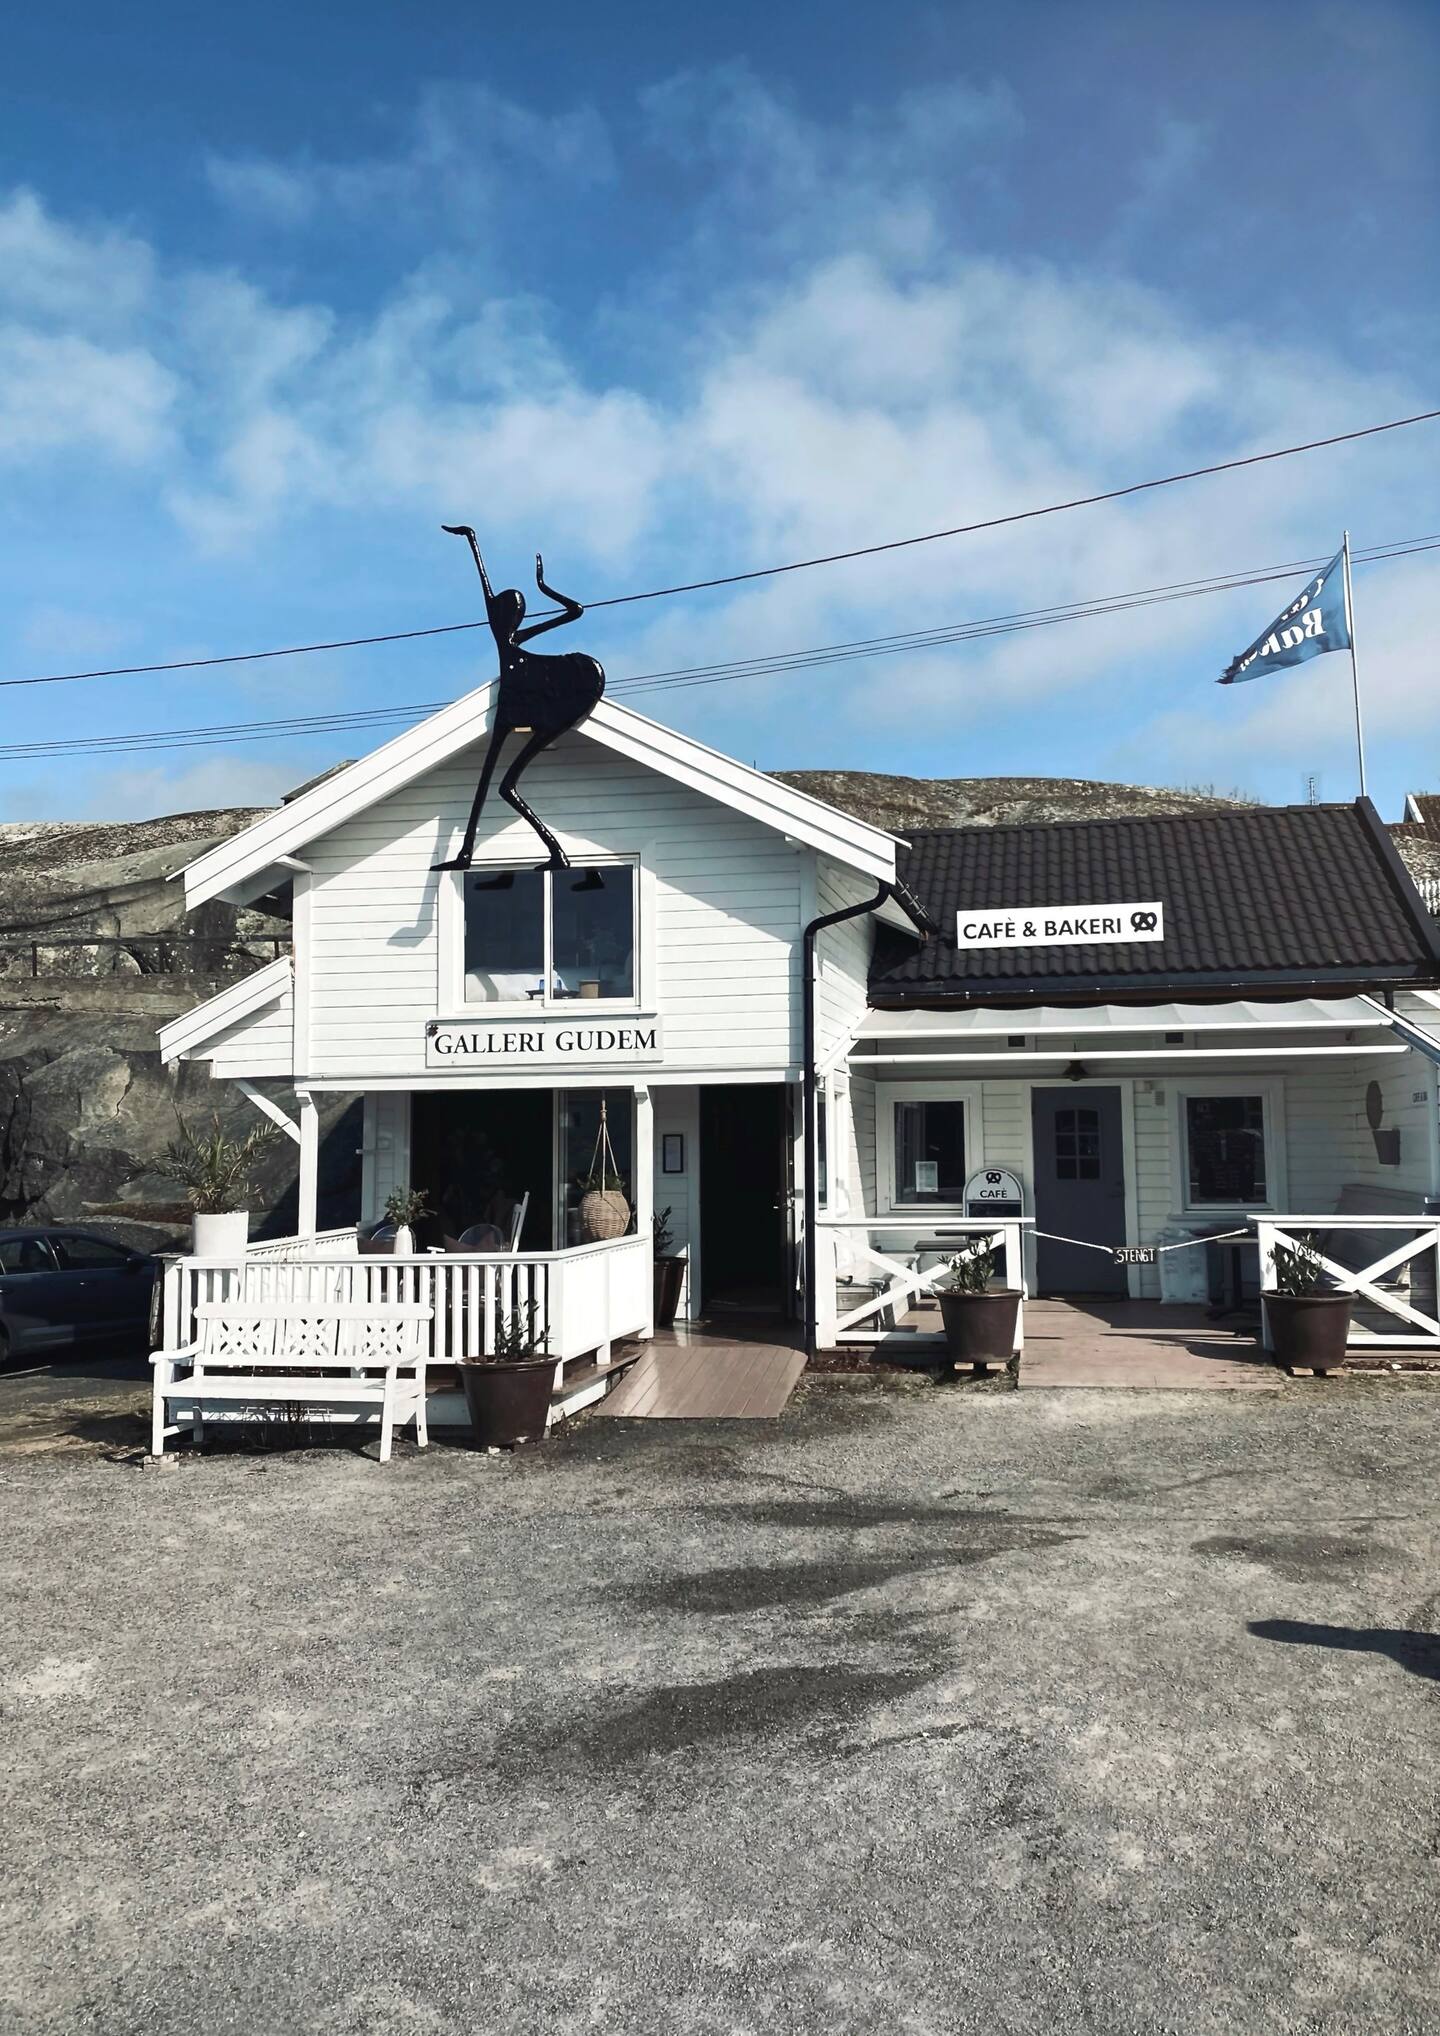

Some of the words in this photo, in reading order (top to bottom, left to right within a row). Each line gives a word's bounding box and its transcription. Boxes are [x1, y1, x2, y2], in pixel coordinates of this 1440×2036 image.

[1022, 921, 1037, 937] &
[1044, 918, 1121, 936] BAKERI
[434, 1032, 545, 1055] GALLERI
[555, 1029, 657, 1051] GUDEM
[1116, 1248, 1155, 1263] STENGT
